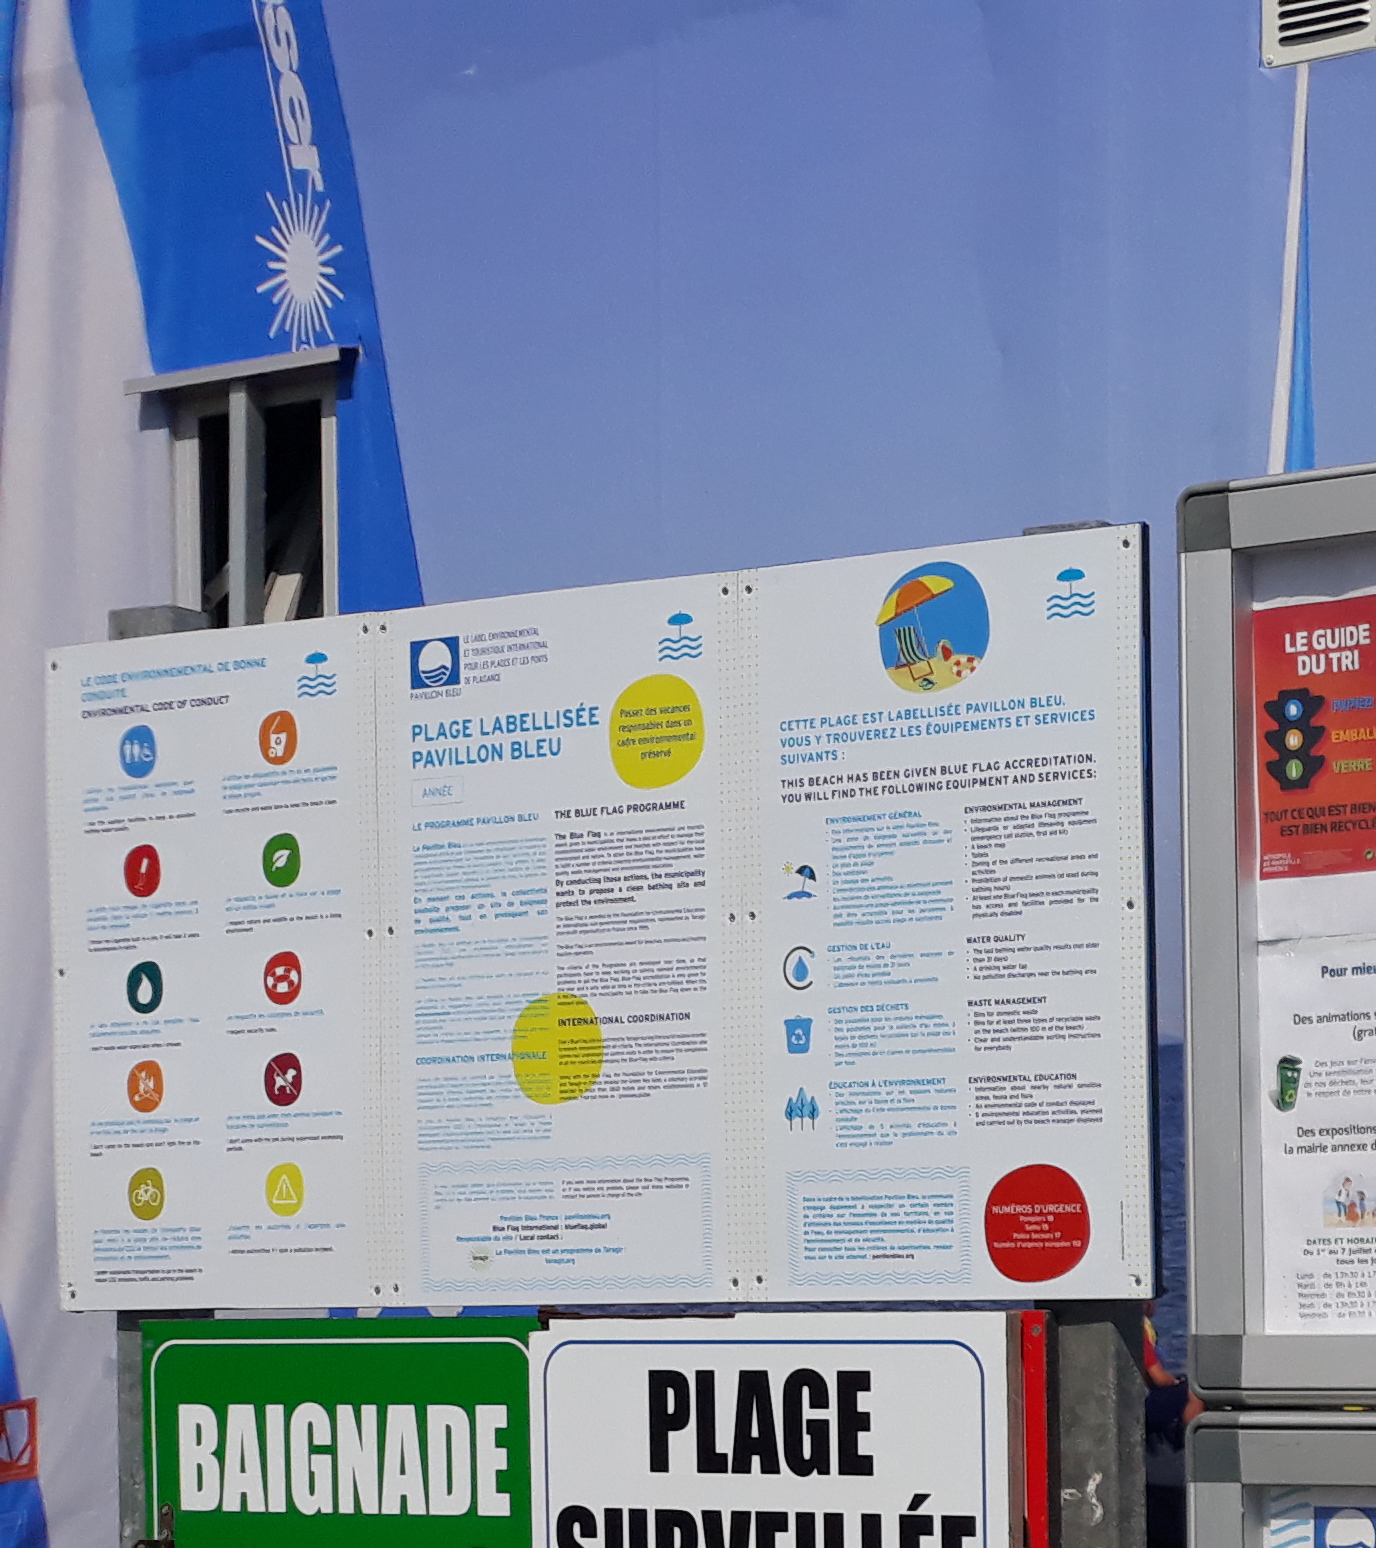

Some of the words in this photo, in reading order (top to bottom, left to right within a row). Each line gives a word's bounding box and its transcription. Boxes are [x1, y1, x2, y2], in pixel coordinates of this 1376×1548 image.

[261, 0, 324, 193] ser
[1285, 631, 1308, 653] LE
[1312, 624, 1370, 650] GUIDE
[1298, 654, 1325, 675] DU
[1329, 650, 1359, 672] TRI
[412, 720, 473, 742] PLAGE
[480, 702, 600, 737] LABELLISÉE
[780, 718, 816, 731] CETTE
[820, 714, 858, 728] PLAGE
[863, 712, 883, 724] EST
[888, 703, 961, 721] LABELLISÉE
[966, 698, 1024, 714] PAVILLON
[412, 743, 502, 769] PAVILLON
[511, 737, 560, 759] BLEU
[1321, 966, 1348, 978] Pour
[648, 1368, 873, 1477] PLAGE
[178, 1401, 512, 1516] BAIGNADE
